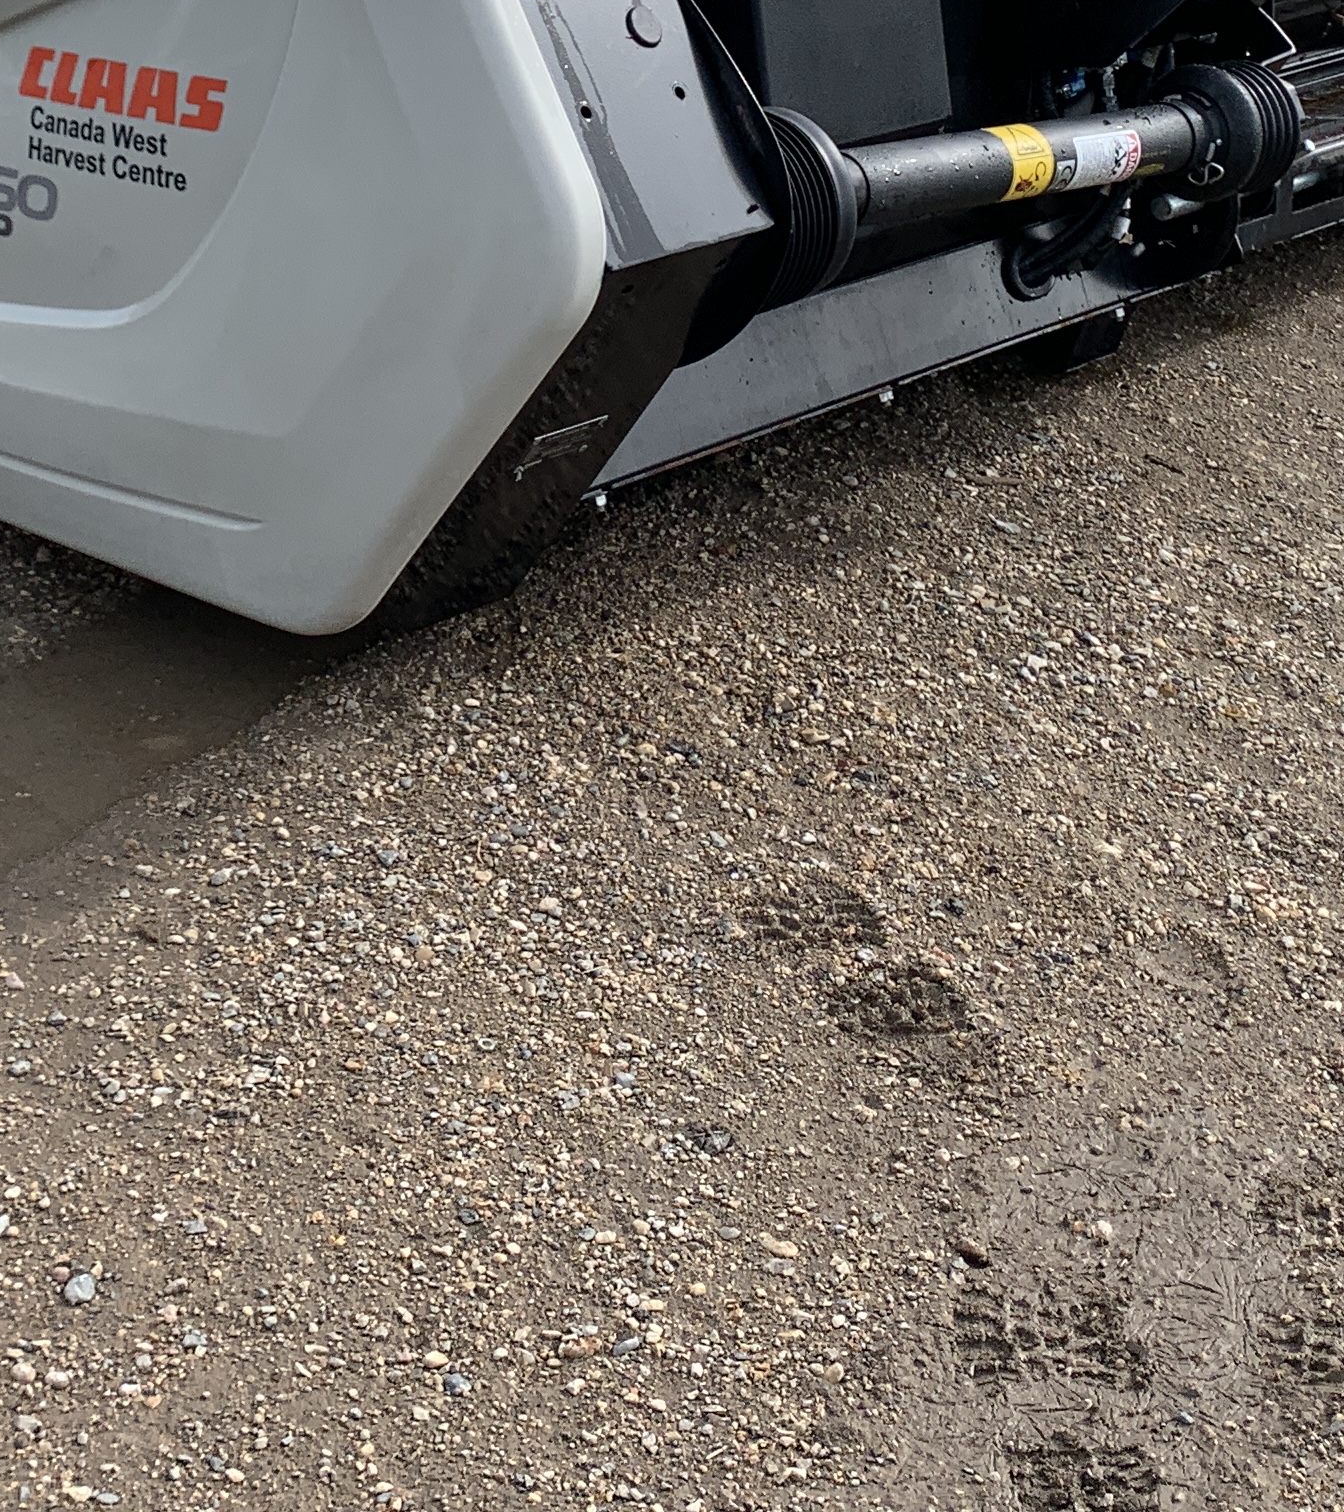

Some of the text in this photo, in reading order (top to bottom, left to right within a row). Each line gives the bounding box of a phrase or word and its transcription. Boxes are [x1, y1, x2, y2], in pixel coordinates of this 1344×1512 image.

[18, 45, 228, 133] CLAAS
[30, 105, 168, 158] Canada West
[27, 135, 188, 193] Harvest Centre
